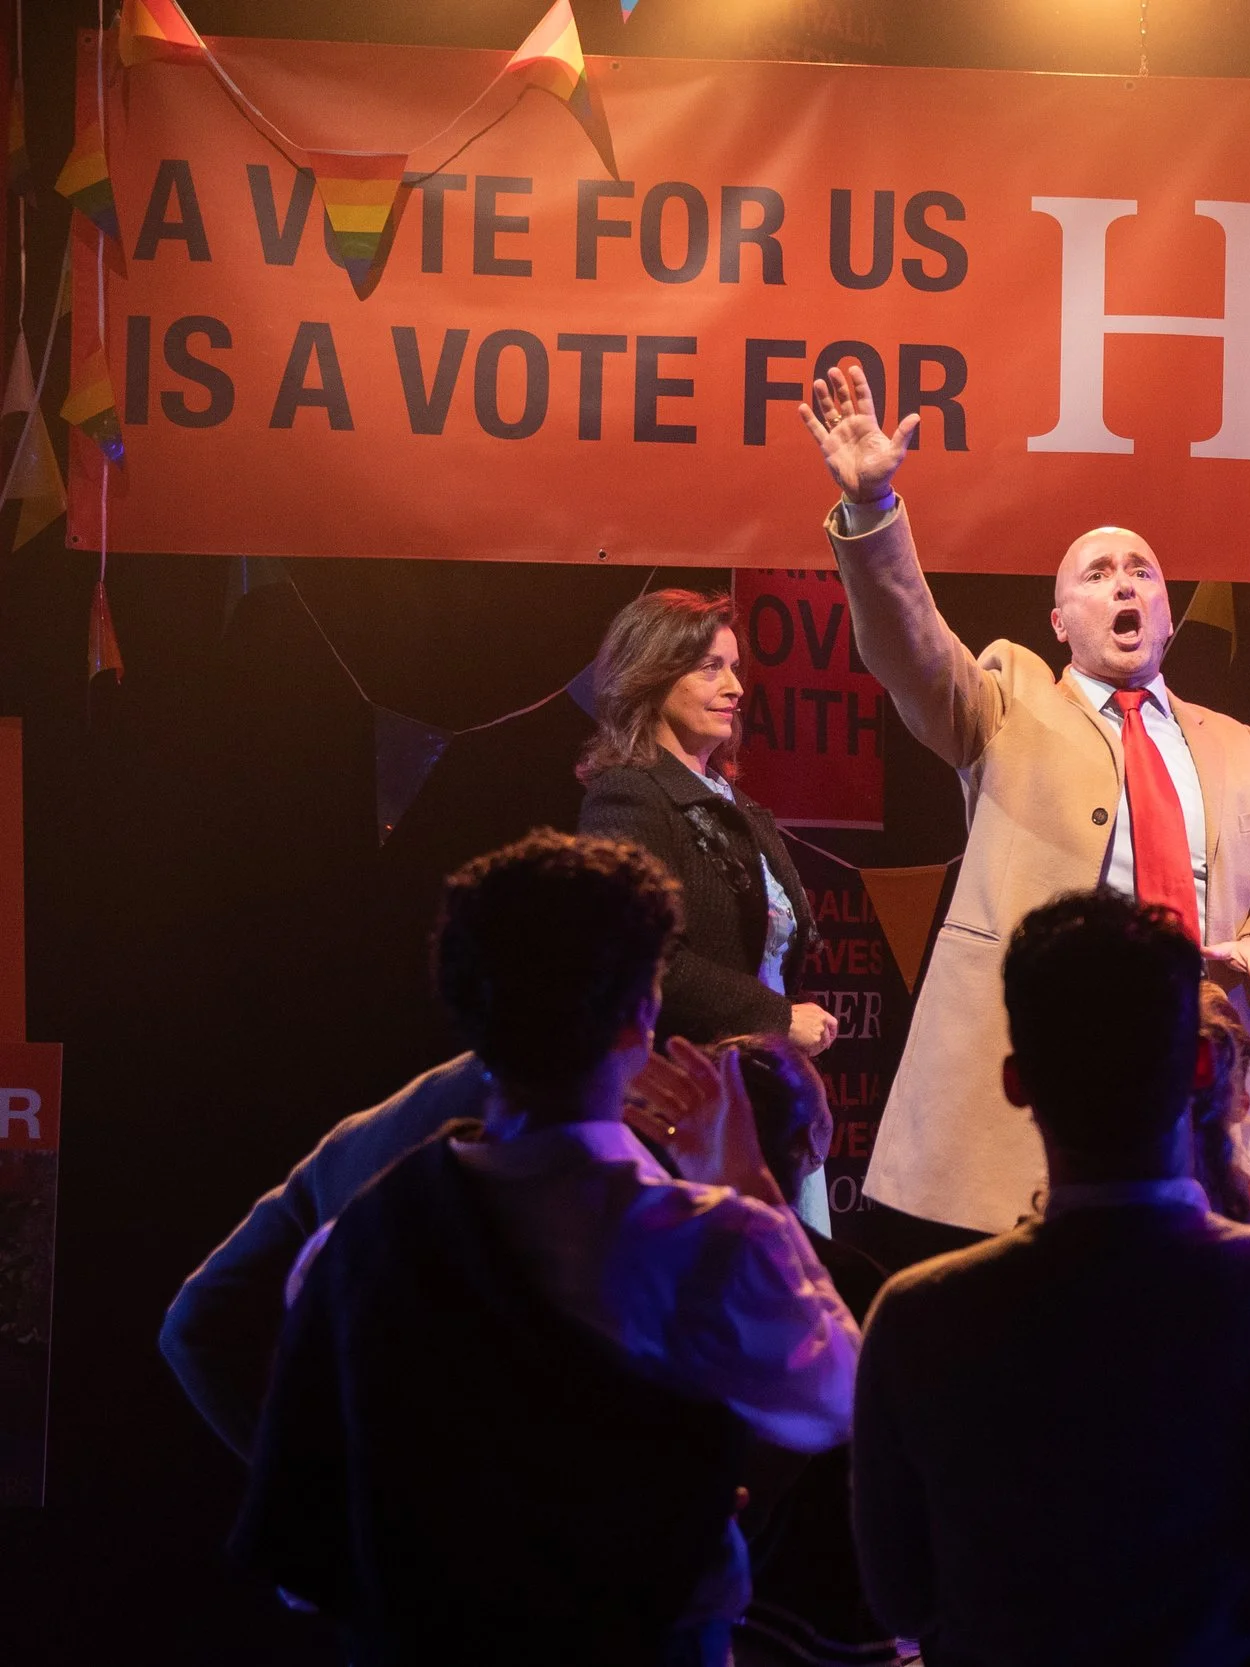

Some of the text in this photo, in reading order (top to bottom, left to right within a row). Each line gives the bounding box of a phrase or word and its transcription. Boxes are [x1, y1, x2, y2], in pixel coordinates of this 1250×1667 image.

[133, 159, 969, 293] A VTE FOR US
[124, 314, 970, 452] IS A VOTE FOR
